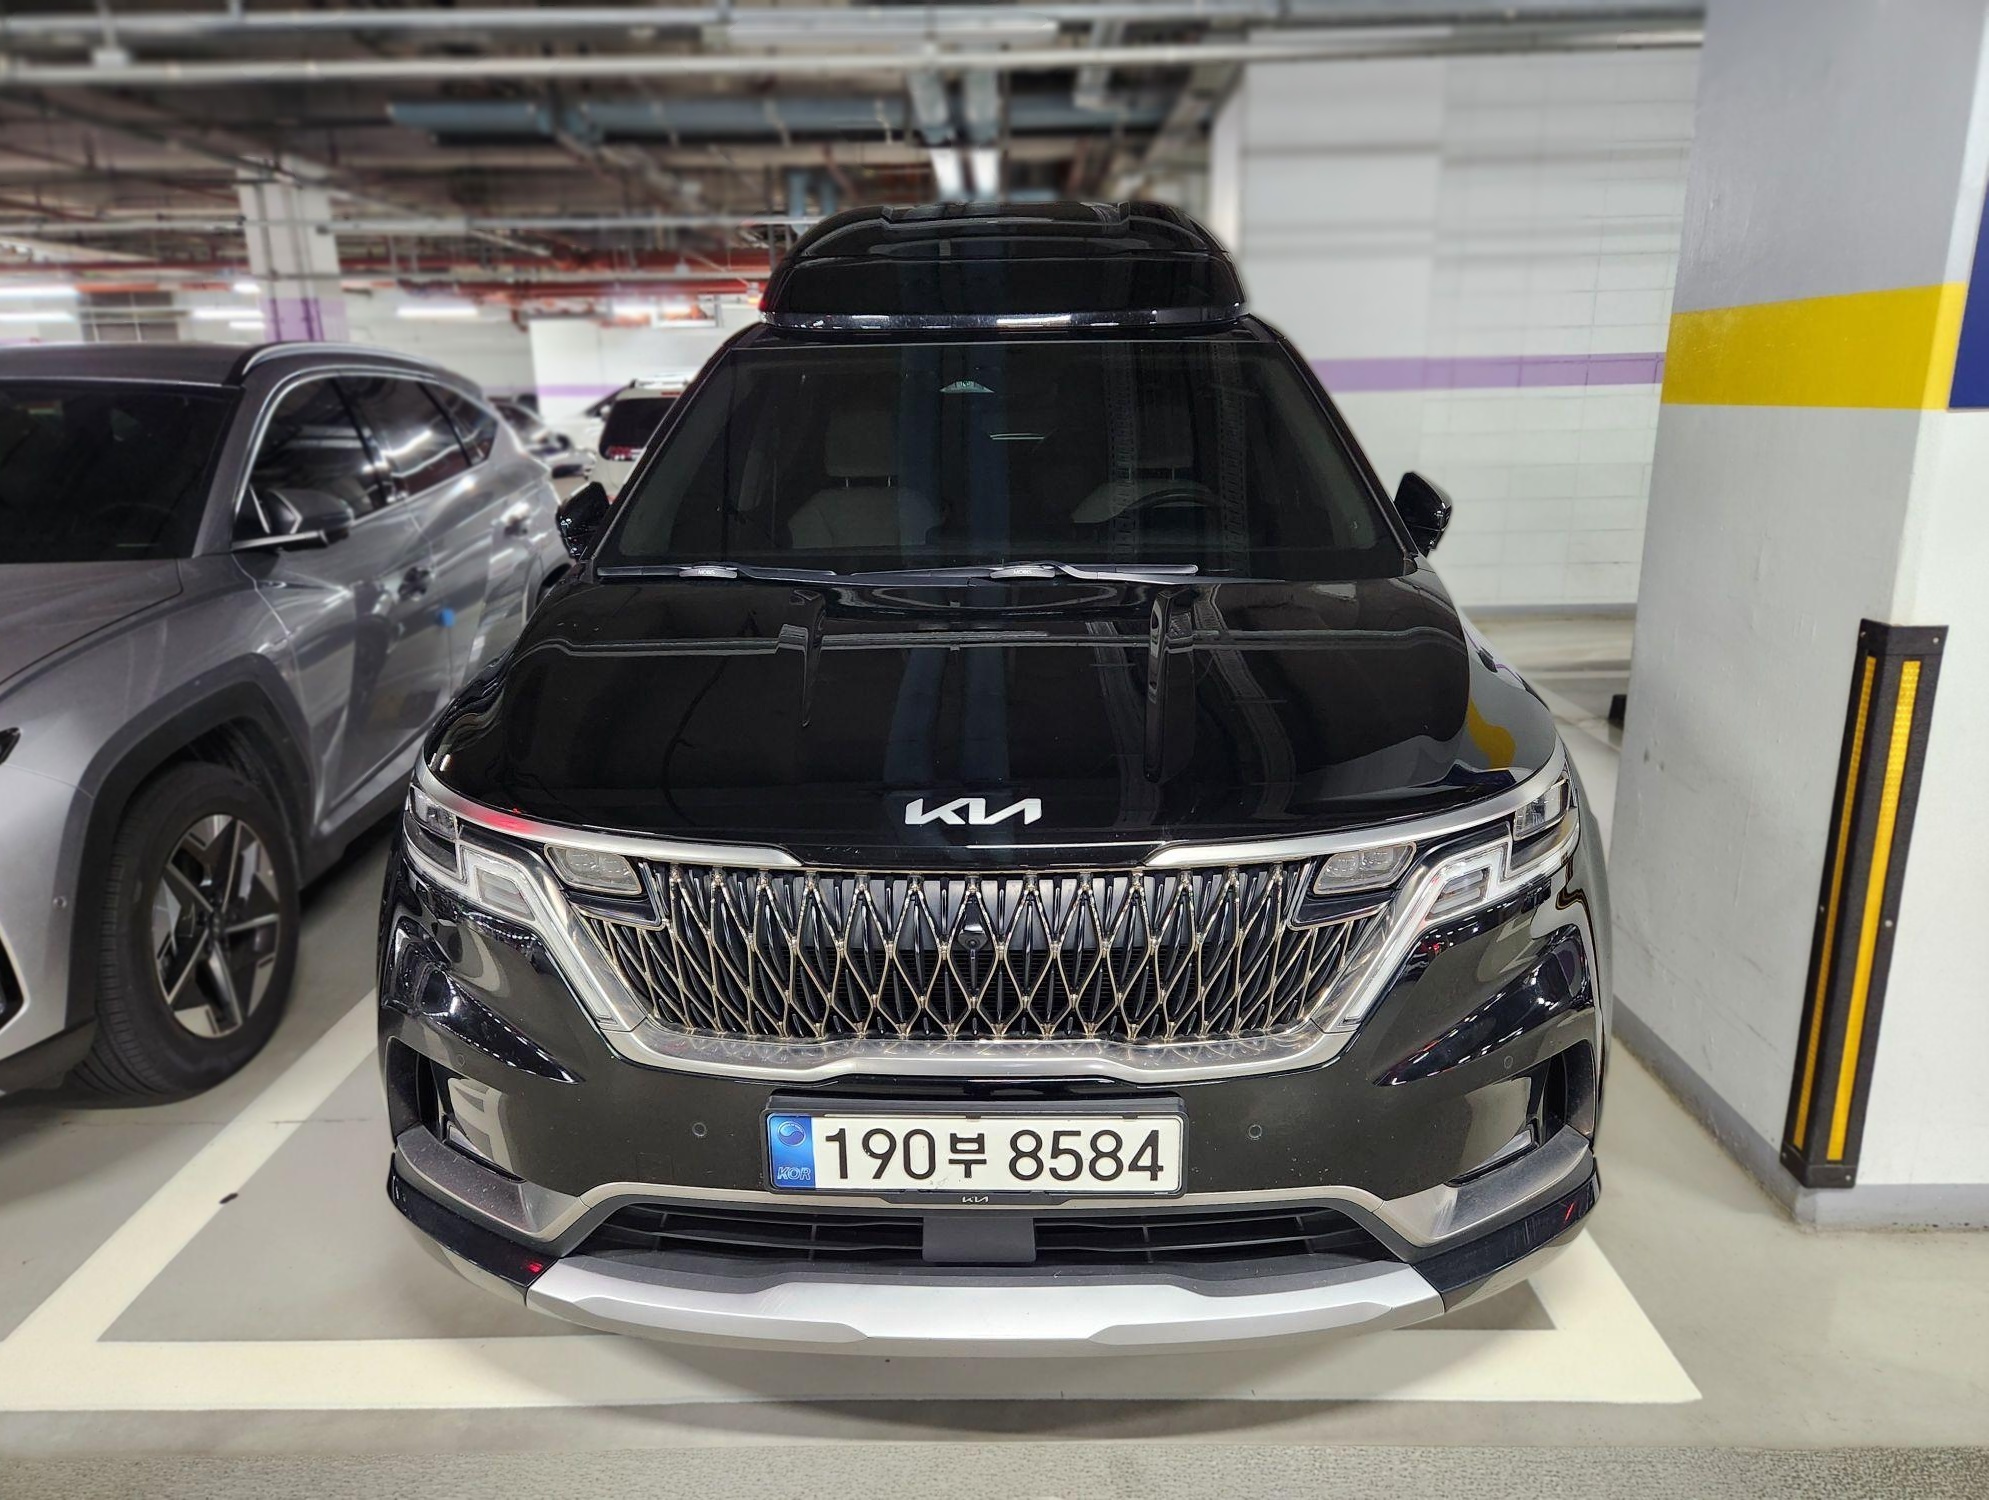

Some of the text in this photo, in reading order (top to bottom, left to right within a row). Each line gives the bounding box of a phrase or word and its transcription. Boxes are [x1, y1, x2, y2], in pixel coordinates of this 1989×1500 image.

[905, 798, 1042, 825] KIA
[826, 1128, 1164, 1182] 190부 8584
[777, 1166, 811, 1180] KOR
